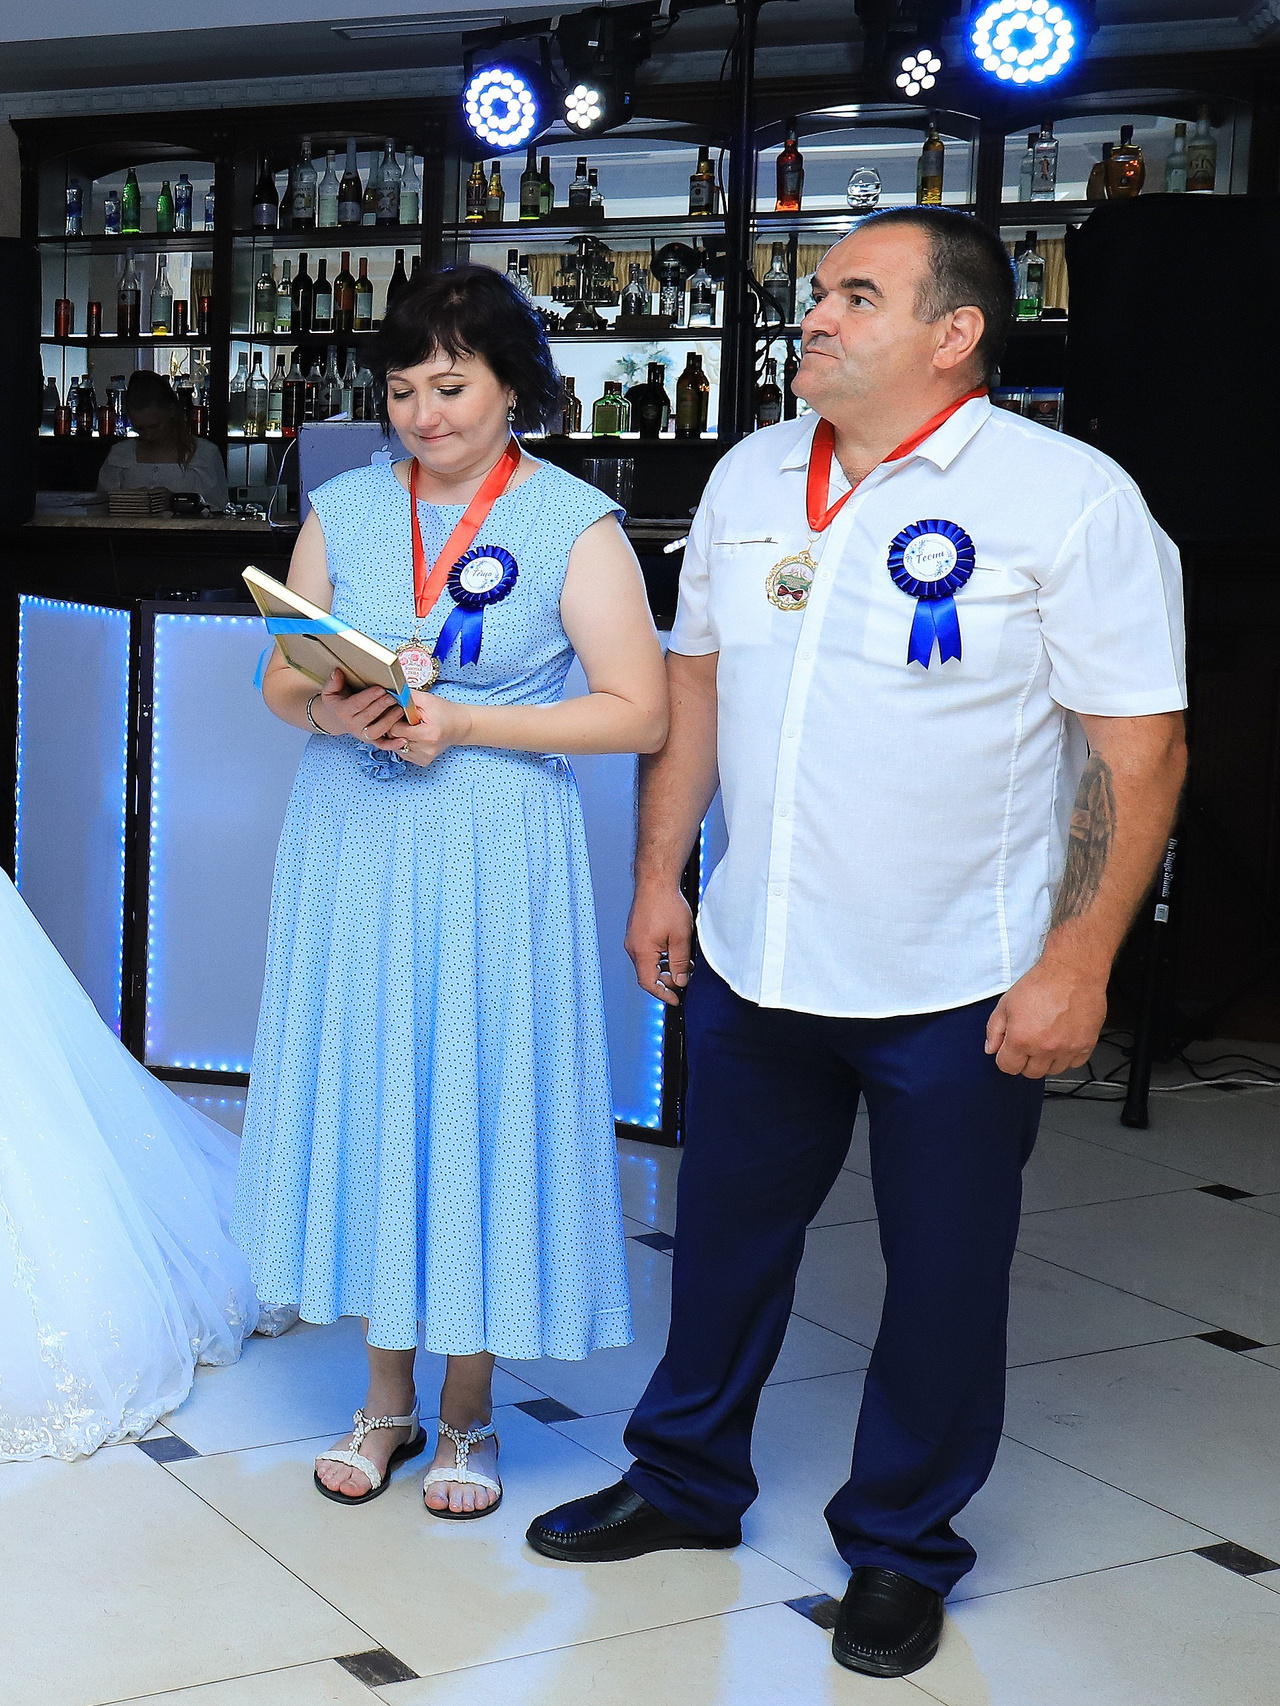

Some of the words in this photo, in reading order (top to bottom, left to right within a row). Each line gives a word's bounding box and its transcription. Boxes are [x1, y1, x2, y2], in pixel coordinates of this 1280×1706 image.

[1189, 158, 1216, 169] GIN
[916, 551, 944, 563] Тесть
[1168, 838, 1178, 850] On
[1164, 851, 1177, 872] Stage
[1161, 872, 1174, 898] Stands
